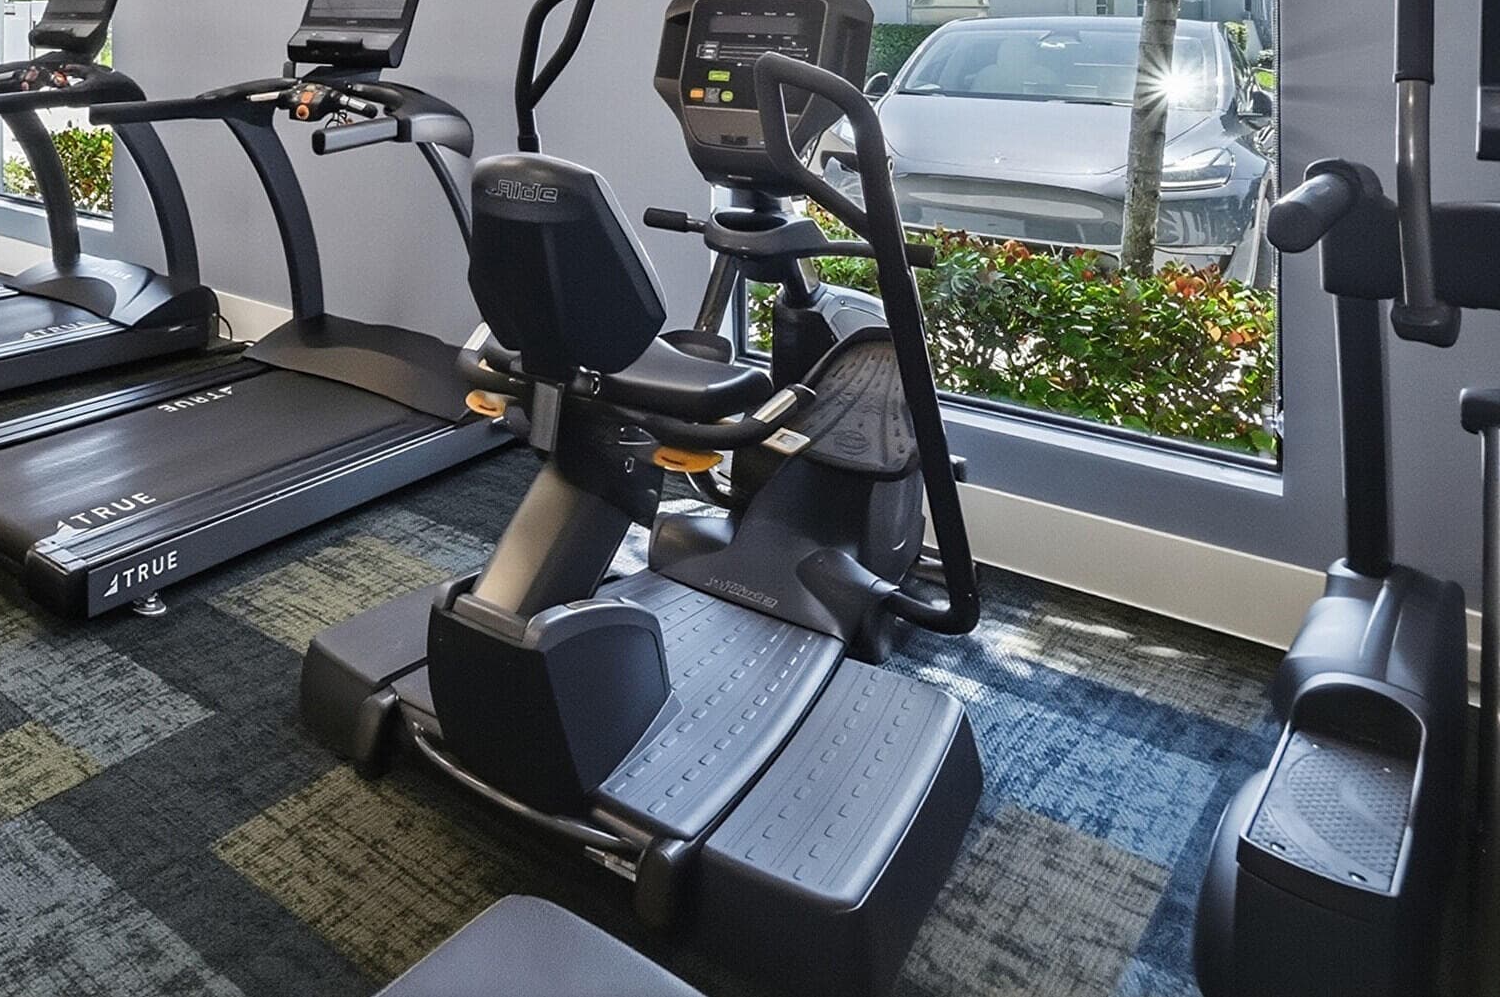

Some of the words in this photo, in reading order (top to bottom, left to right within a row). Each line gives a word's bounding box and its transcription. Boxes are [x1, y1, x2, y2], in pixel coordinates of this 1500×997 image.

[157, 392, 226, 413] TRUE
[69, 492, 157, 525] TRUE
[122, 550, 178, 588] TRUE
